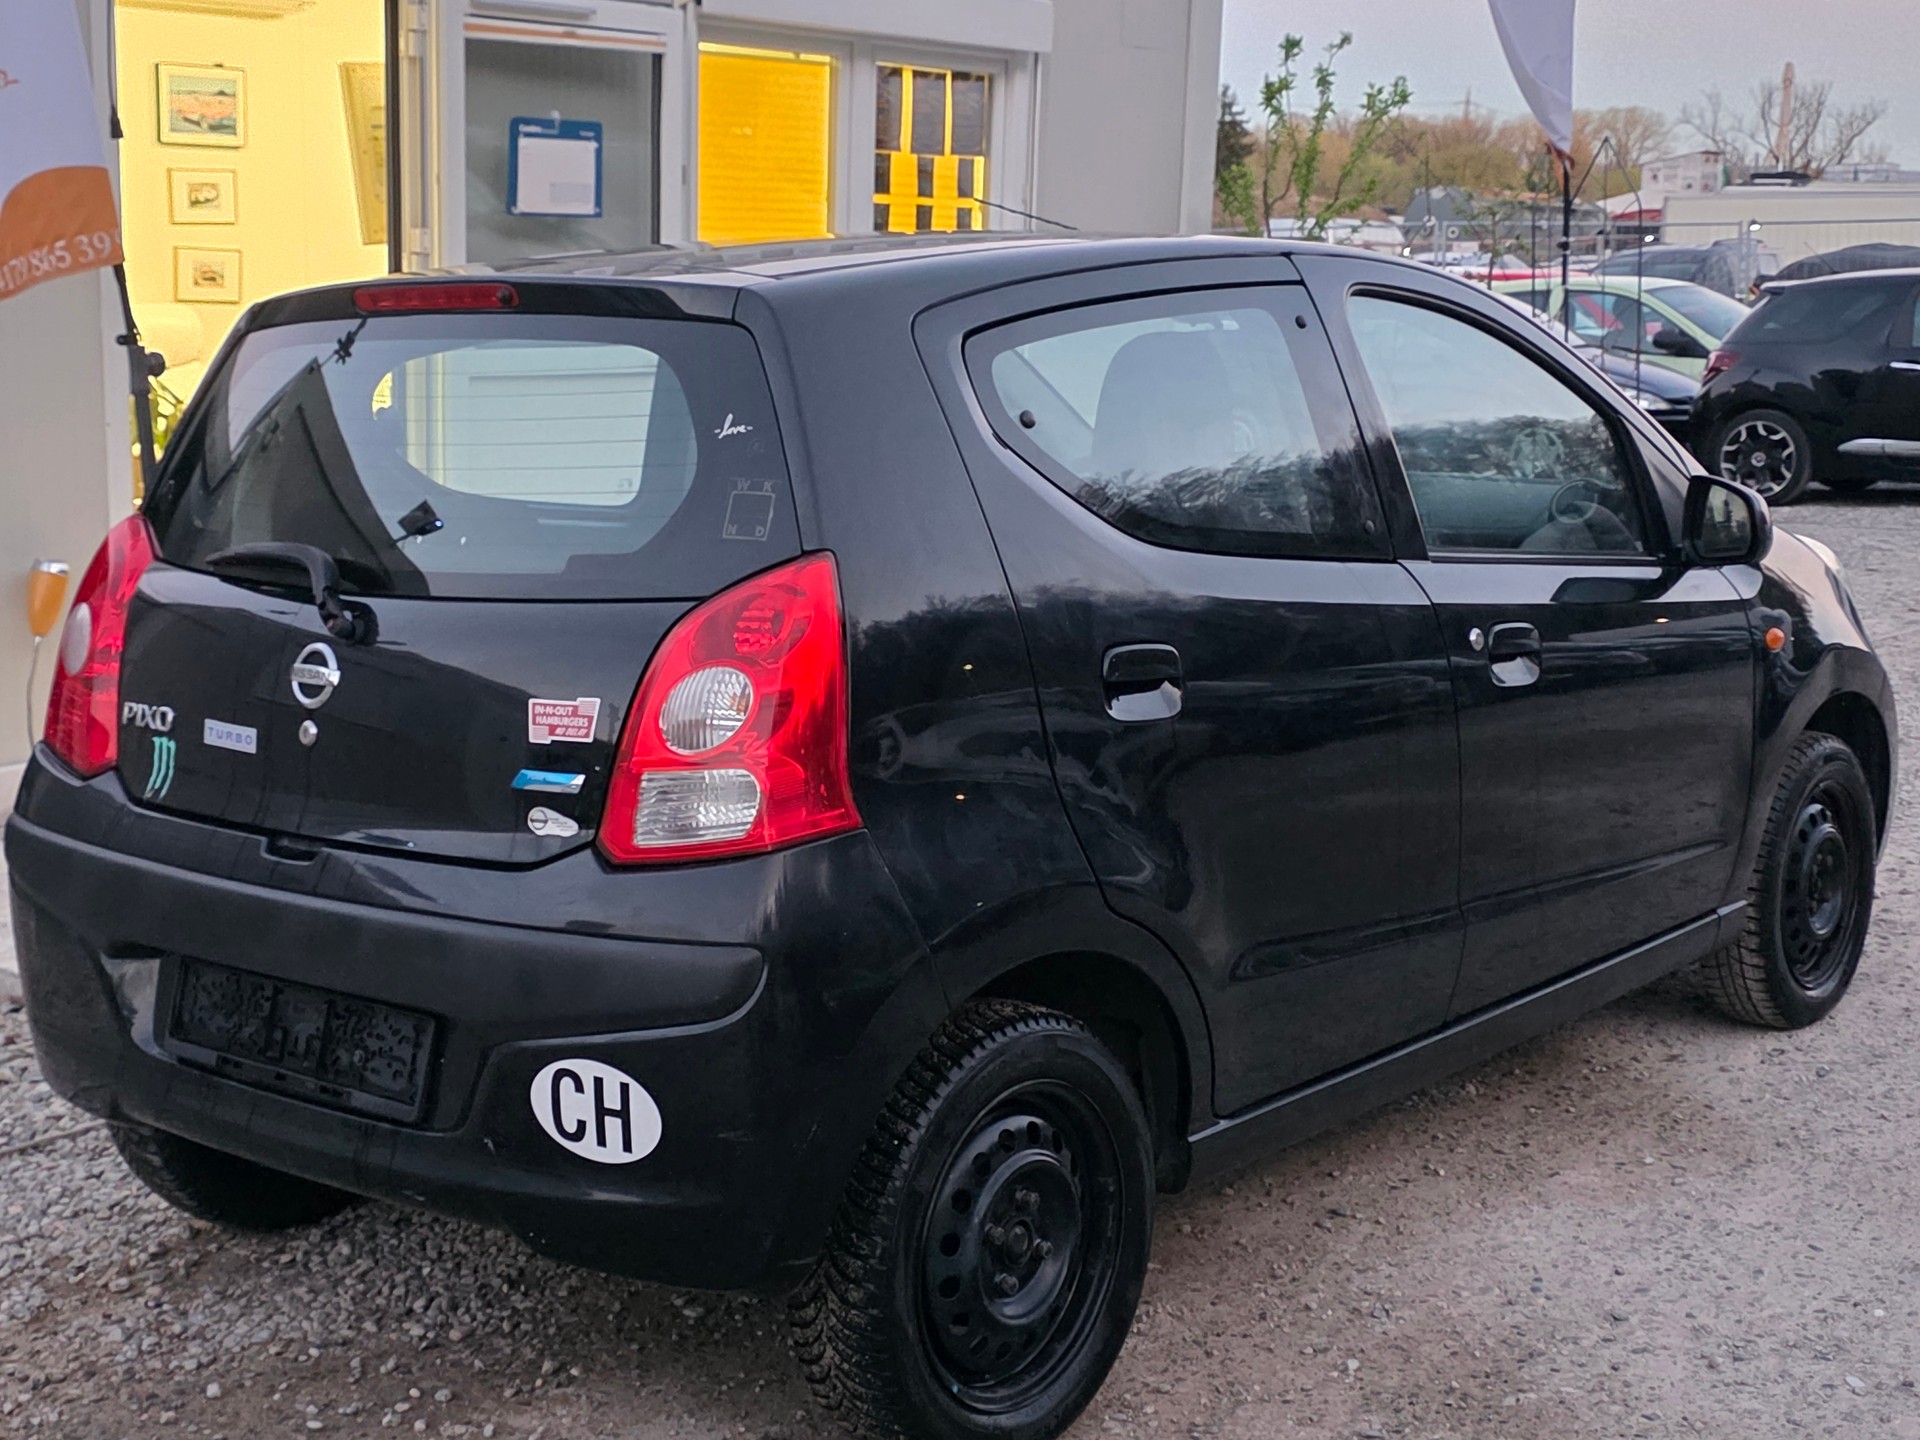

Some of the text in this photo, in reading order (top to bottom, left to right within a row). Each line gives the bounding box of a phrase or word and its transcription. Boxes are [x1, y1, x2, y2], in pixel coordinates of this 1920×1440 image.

[122, 701, 175, 732] PIXO
[534, 704, 574, 716] IN-N-OUT
[536, 715, 589, 727] HAMBURGERS
[207, 727, 253, 746] TURBO
[550, 1067, 633, 1154] CH
